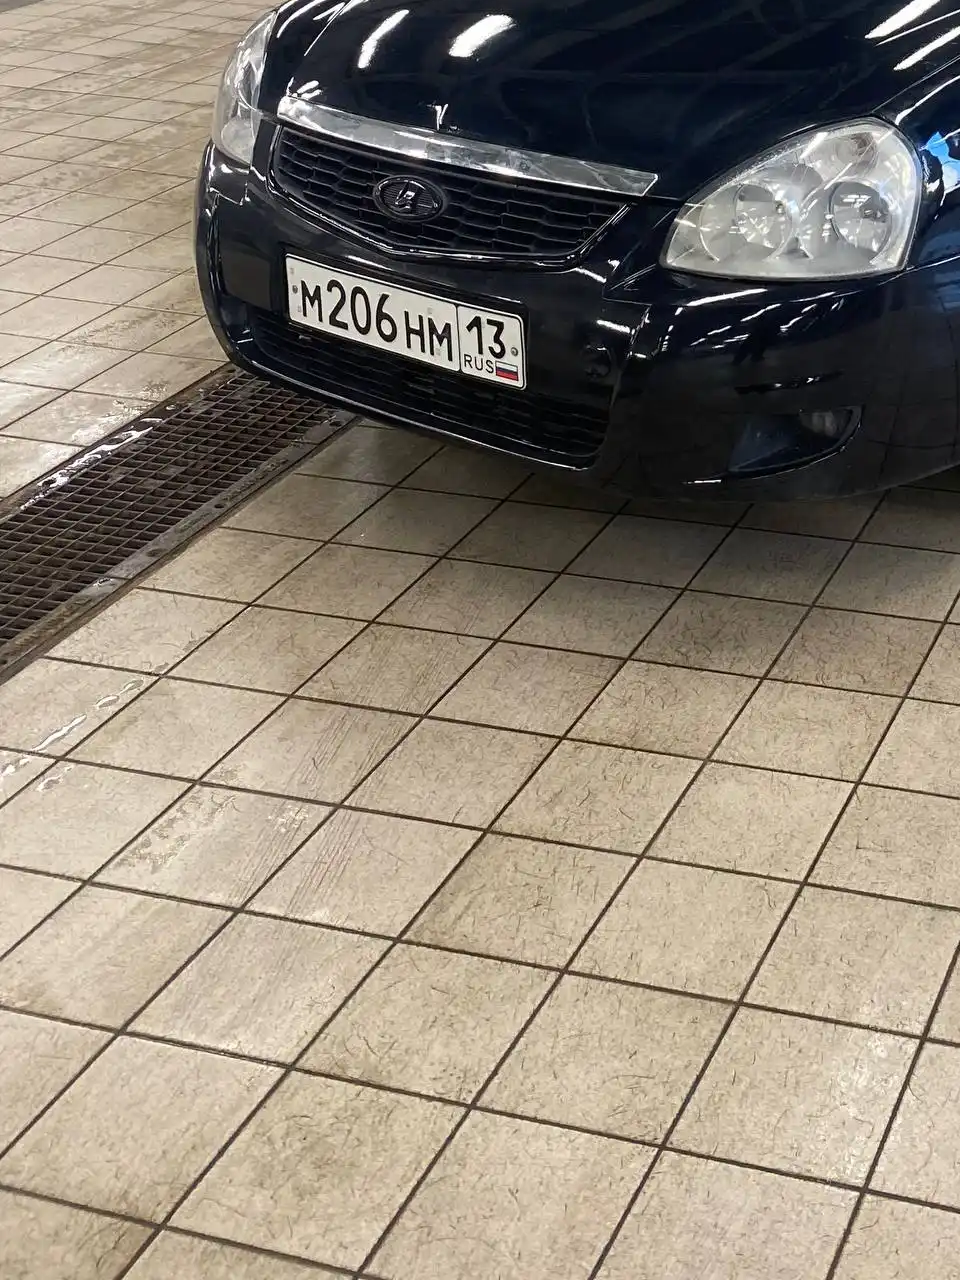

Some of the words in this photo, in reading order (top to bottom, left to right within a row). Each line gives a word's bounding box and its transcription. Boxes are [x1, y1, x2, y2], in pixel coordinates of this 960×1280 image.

[300, 279, 453, 362] М206НМ
[466, 315, 507, 360] 13
[464, 353, 494, 374] RUS
